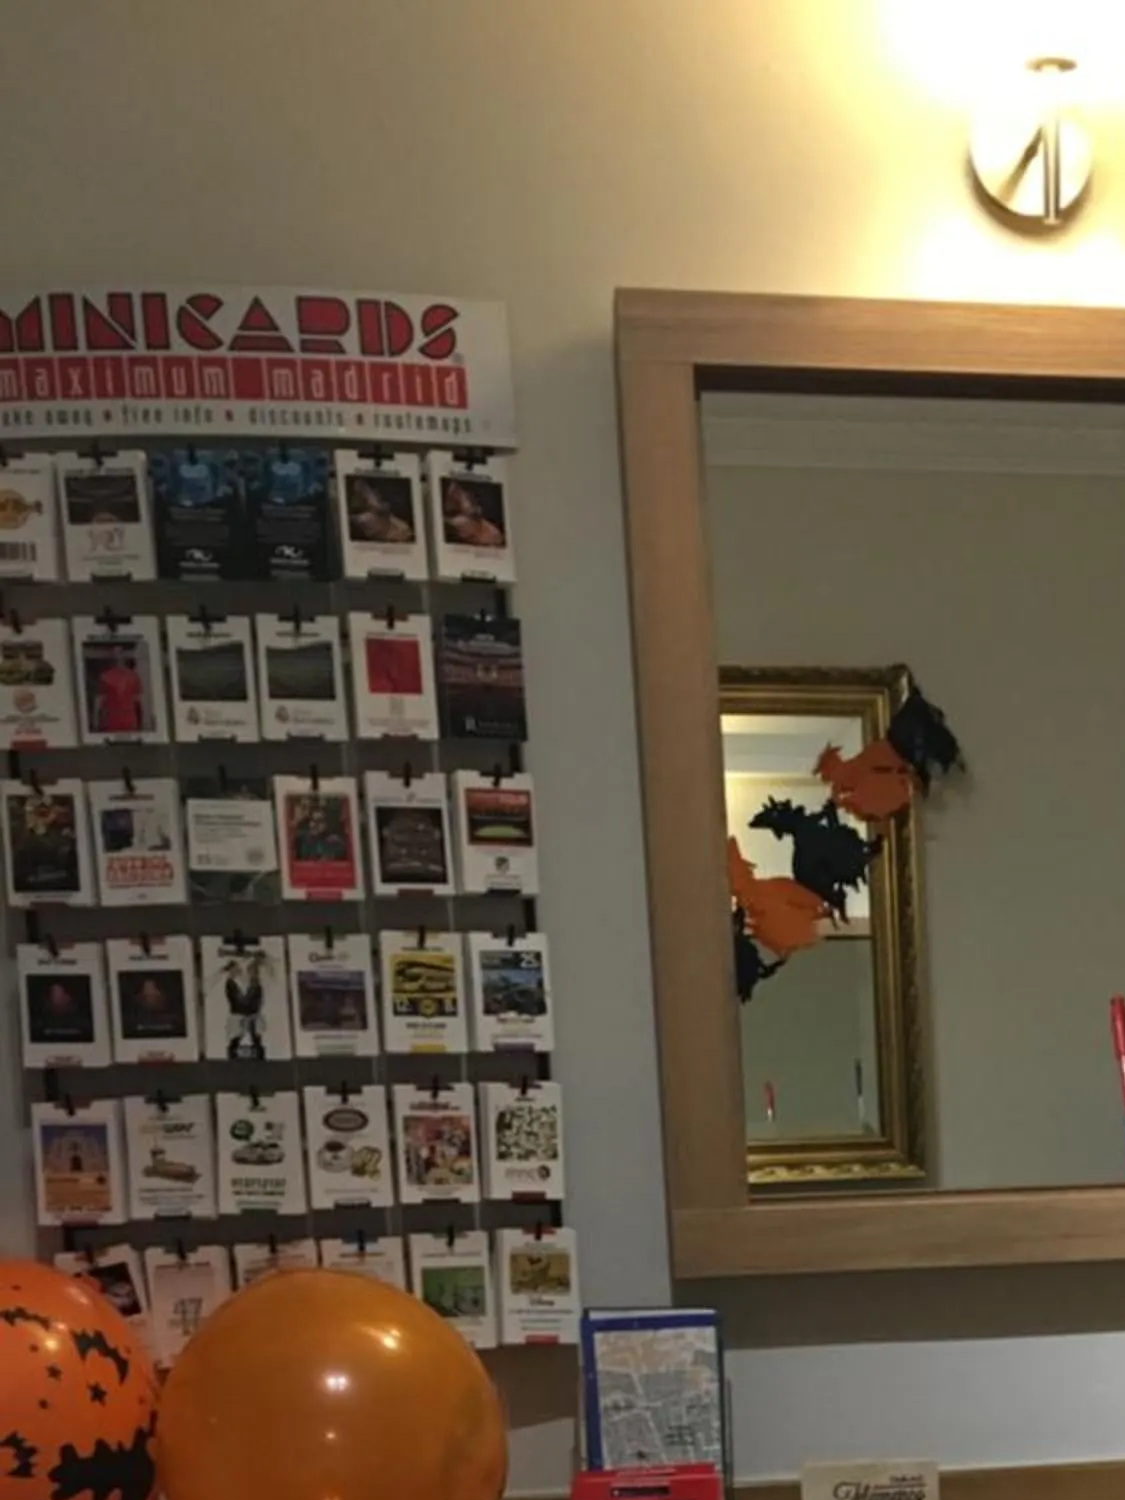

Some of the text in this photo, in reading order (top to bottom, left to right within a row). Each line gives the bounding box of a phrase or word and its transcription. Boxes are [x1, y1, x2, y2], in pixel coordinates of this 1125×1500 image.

[0, 292, 460, 360] MINICARDS
[0, 365, 458, 405] maximum madrid
